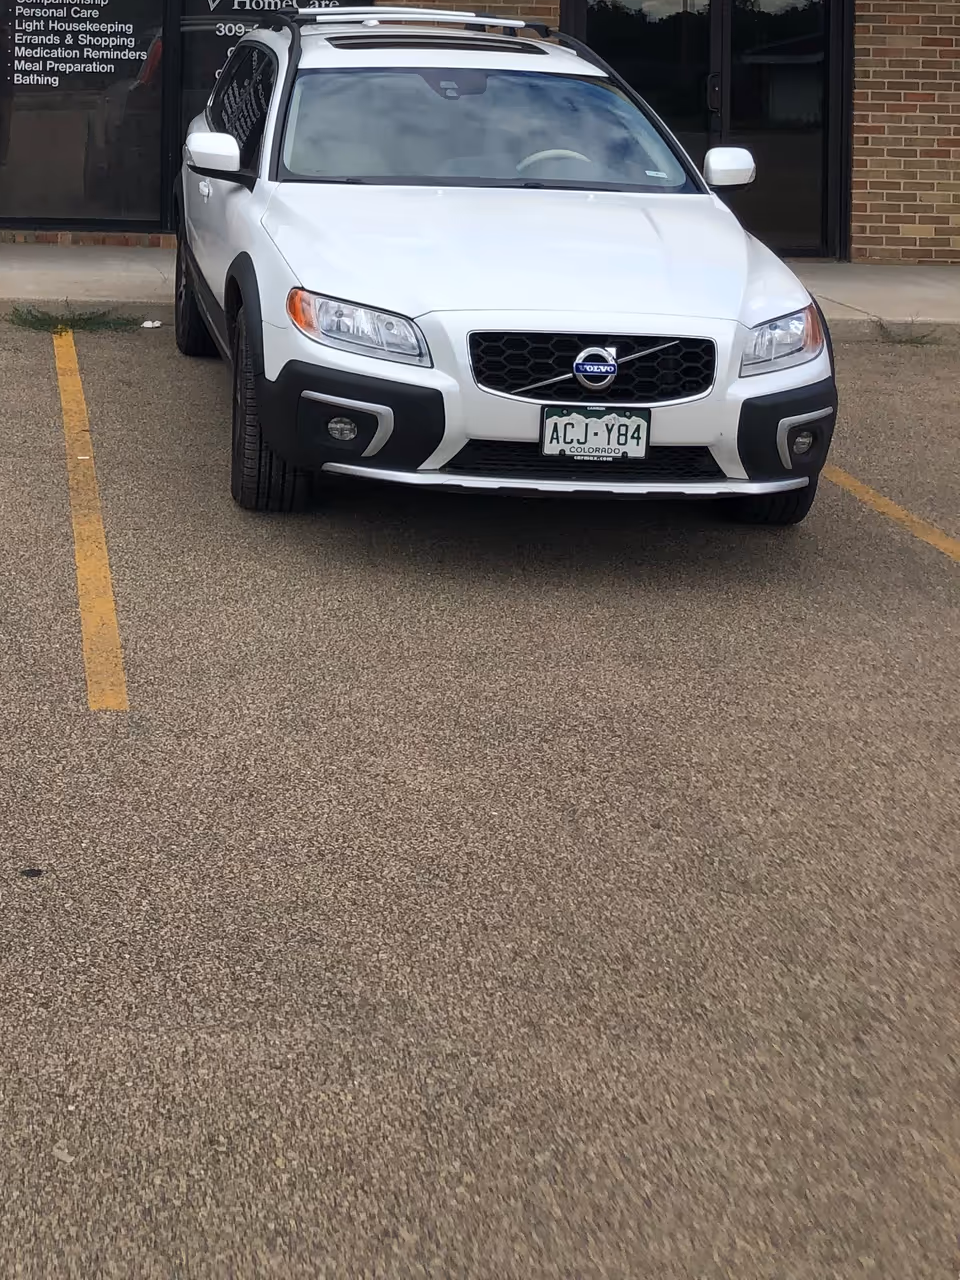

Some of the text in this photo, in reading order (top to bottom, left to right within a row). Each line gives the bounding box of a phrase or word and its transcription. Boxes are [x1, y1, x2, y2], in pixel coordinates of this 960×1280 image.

[15, 5, 100, 18] Personal Care
[14, 19, 134, 34] Light Housekeeping
[14, 32, 135, 48] Errands & Shopping
[14, 46, 148, 60] Medication Reminders
[14, 59, 115, 74] Meal Preparation
[13, 73, 59, 87] Bathing
[578, 364, 615, 373] VOLVO
[569, 446, 621, 455] COLORADO
